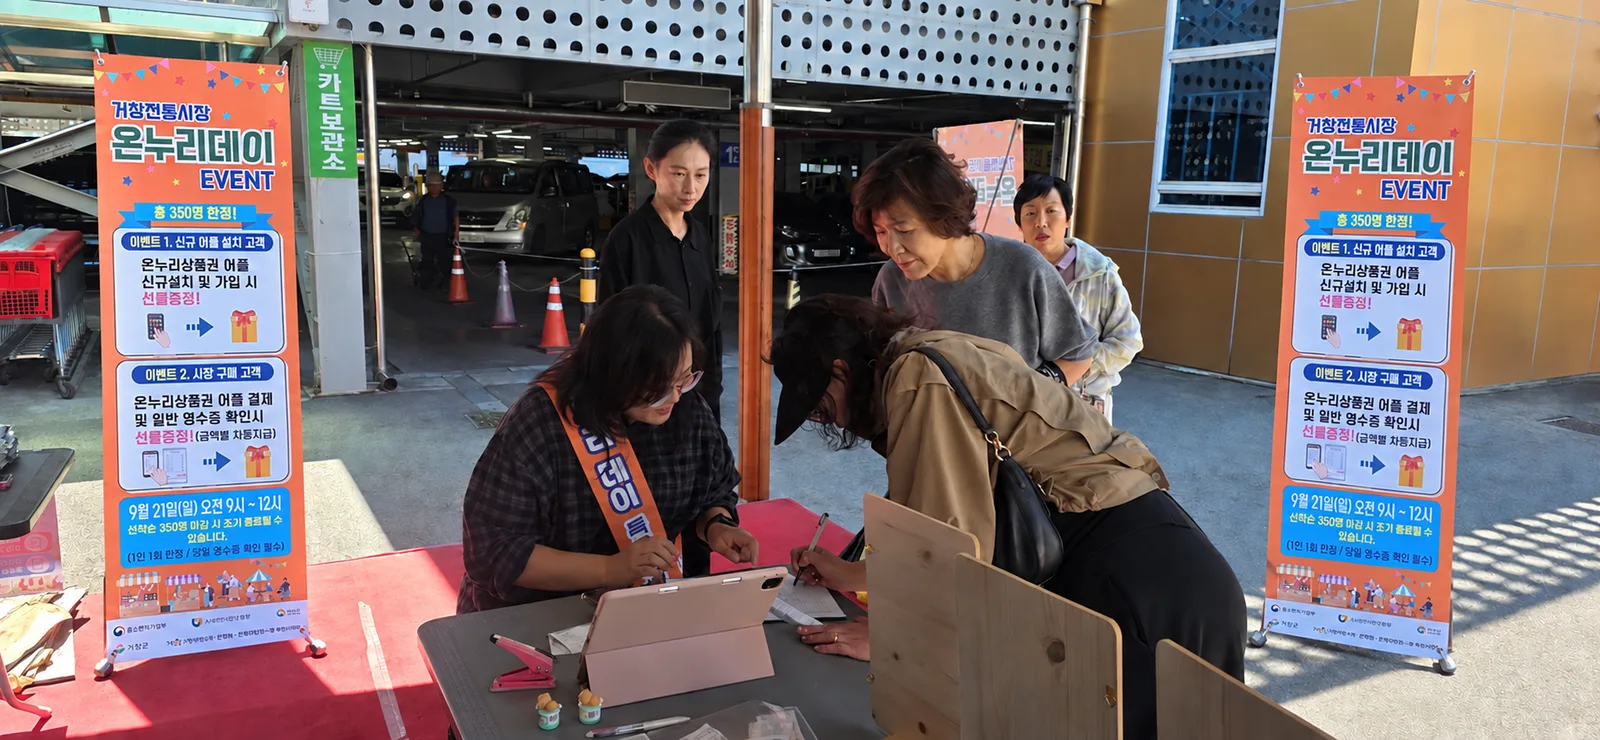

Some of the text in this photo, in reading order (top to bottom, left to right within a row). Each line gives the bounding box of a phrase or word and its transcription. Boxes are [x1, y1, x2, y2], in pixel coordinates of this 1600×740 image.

[111, 101, 211, 122] 거창전통시장
[318, 72, 346, 171] 카트보관소
[1306, 116, 1398, 136] 거창전통시장
[110, 125, 275, 165] 온누리데이
[1302, 139, 1455, 176] 온누리데이
[200, 169, 275, 190] EVENT
[1380, 180, 1452, 200] EVENT
[169, 207, 203, 219] 350명
[208, 208, 237, 220] 한정!
[1351, 214, 1382, 227] 350명
[1386, 216, 1413, 228] 한정!
[130, 236, 265, 249] 이벤트 1. 신규 어플 설치 고객
[1312, 242, 1437, 258] 이벤트 1. 신규 어플 설치 고객
[141, 258, 249, 272] 온누리상품권 어플
[1321, 263, 1420, 280] 온누리상품권 어플
[142, 275, 257, 289] 신규설치 및 가입 시
[1320, 279, 1426, 296] 신규설치 및 가입 시
[142, 292, 200, 306] 선물증정!
[1319, 296, 1372, 310] 선물증정!
[145, 366, 262, 381] 이벤트 2. 시장 구매 고객
[1315, 367, 1422, 387] 이벤트 2. 시장 구매 고객
[134, 392, 273, 409] 온누리상품권 어플 결제
[1304, 392, 1431, 415] 온누리상품권 어플 결제
[135, 410, 264, 427] 및 일반 영수증 확인시
[1304, 409, 1420, 432] 및 일반 영수증 확인시
[135, 429, 276, 444] 선물증정! (금액별 차등지급)
[1302, 425, 1431, 449] 선물증정! (금액별 차등지급)
[129, 503, 149, 519] 9월
[153, 500, 197, 518] 21일(일)
[201, 498, 223, 514] 오전
[226, 497, 245, 513] 9시
[258, 495, 282, 511] 12시
[1291, 493, 1308, 509] 9월
[1311, 495, 1352, 515] 21일(일)
[1355, 499, 1375, 517] 오전
[1378, 501, 1395, 519] 9시
[1409, 506, 1433, 523] 12시
[160, 522, 187, 533] 350명
[212, 519, 220, 529] 시
[223, 517, 242, 528] 조기
[274, 516, 283, 525] 수
[1318, 516, 1344, 529] 350명
[1365, 520, 1374, 531] 시
[1376, 522, 1393, 533] 조기
[1424, 526, 1433, 537] 수
[187, 532, 227, 544] 있습니다.
[1338, 531, 1375, 545] 있습니다.
[128, 550, 146, 563] (1인
[149, 549, 163, 561] 1회
[186, 547, 191, 558] /
[213, 543, 241, 555] 영수증
[1287, 541, 1303, 552] (1인
[1305, 542, 1317, 553] 1회
[1339, 545, 1343, 556] /
[1345, 547, 1362, 558] 당일
[1365, 549, 1390, 561] 영수증
